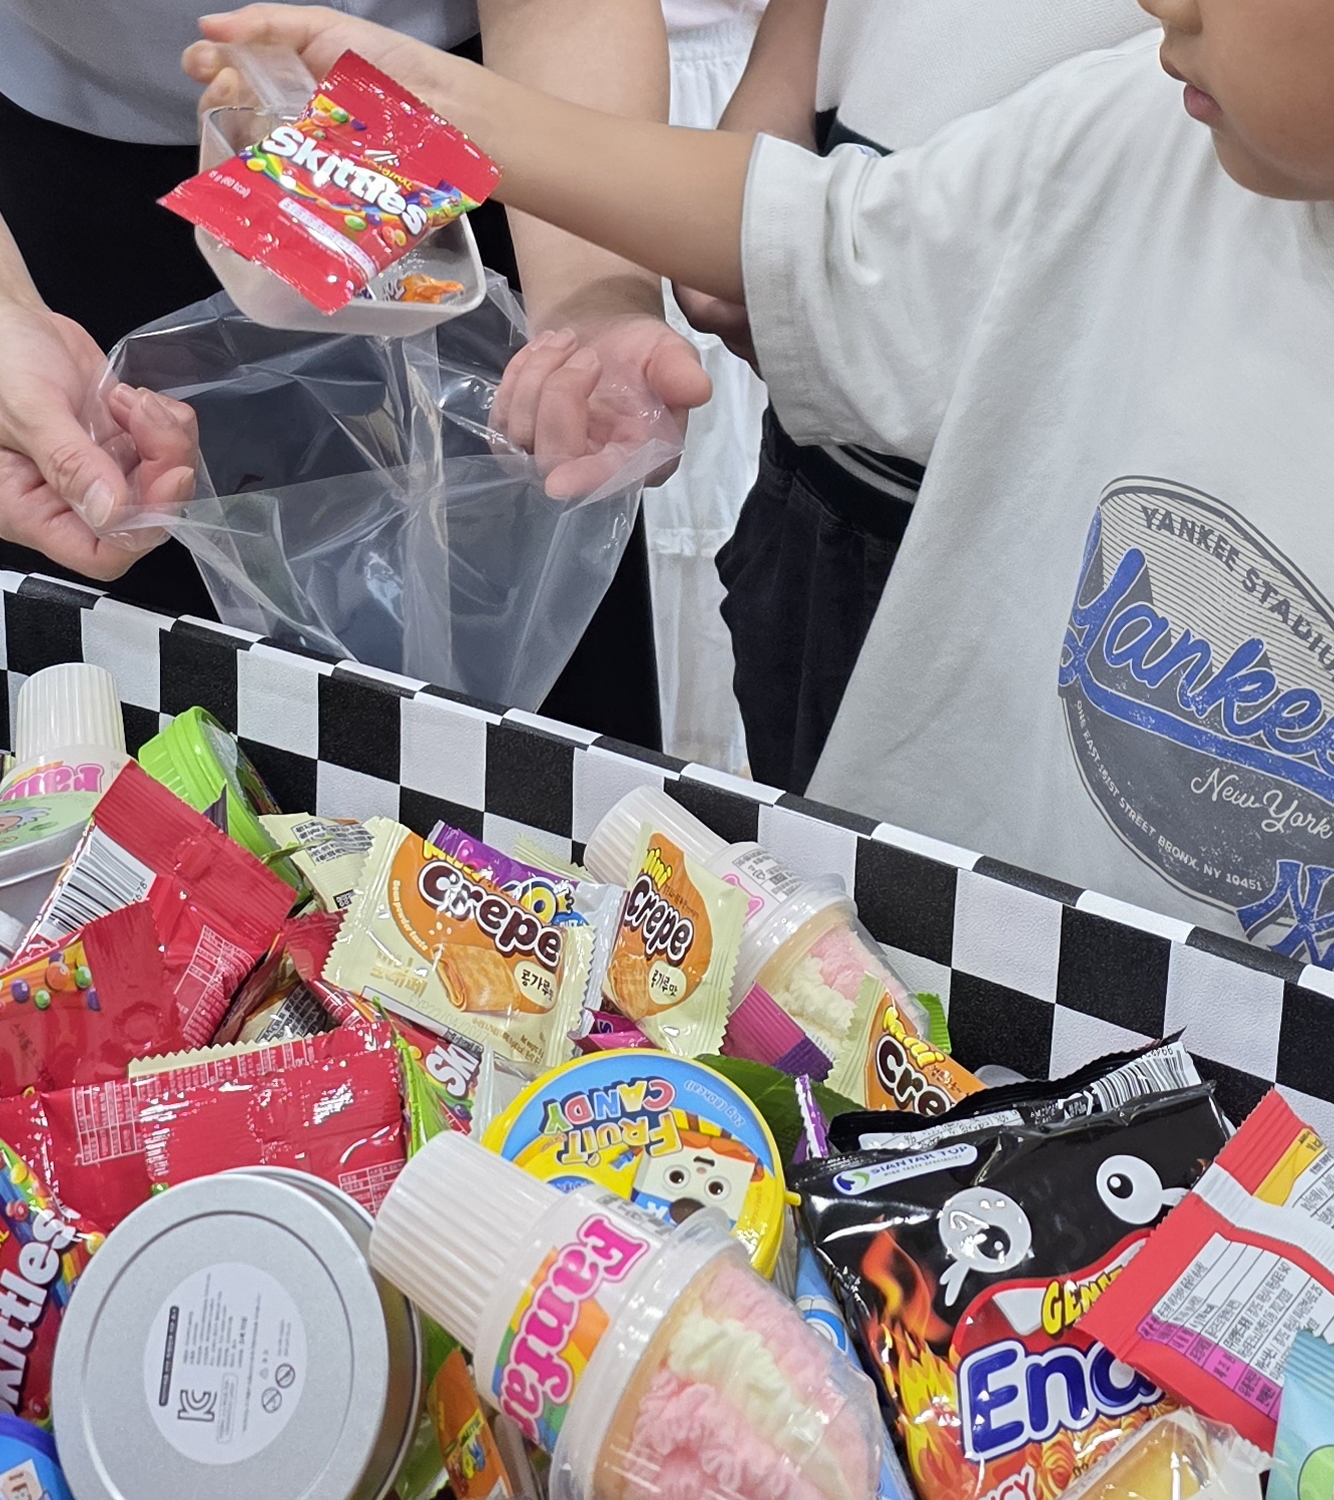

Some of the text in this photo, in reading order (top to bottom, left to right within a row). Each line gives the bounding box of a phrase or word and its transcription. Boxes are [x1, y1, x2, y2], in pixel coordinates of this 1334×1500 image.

[1140, 504, 1243, 575] YANKEE
[1083, 727, 1103, 763] EAST
[1118, 794, 1158, 842] STREET
[1156, 832, 1203, 875] BRONX,
[1202, 861, 1222, 882] NY
[1224, 871, 1265, 894] 10451
[1190, 766, 1334, 841] New York
[417, 859, 565, 974] Crepe
[623, 872, 695, 967] Crepe
[542, 1076, 676, 1136] CANDY
[875, 1032, 955, 1118] Cre
[960, 1340, 1165, 1462] Ena
